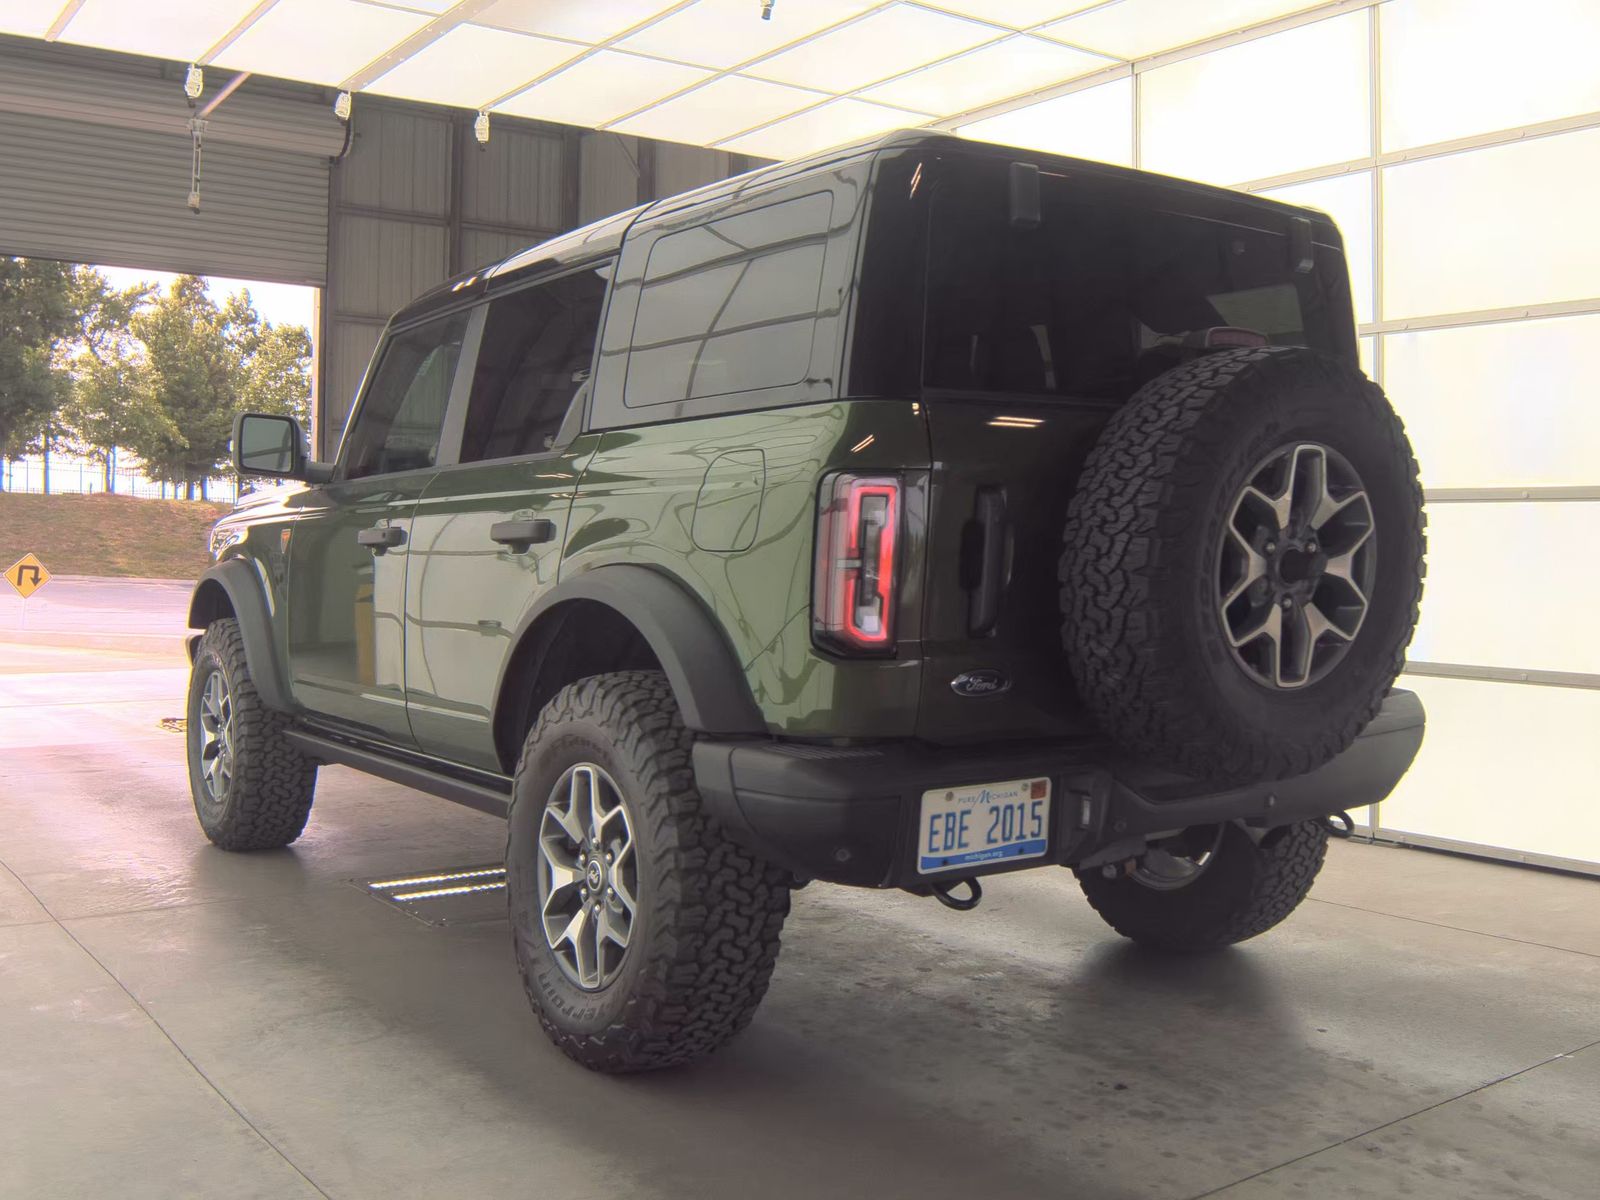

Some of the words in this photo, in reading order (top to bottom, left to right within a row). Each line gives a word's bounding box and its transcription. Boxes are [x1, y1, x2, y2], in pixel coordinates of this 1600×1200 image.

[966, 676, 998, 691] Ford
[928, 809, 972, 853] EBE
[986, 800, 1043, 844] 2015
